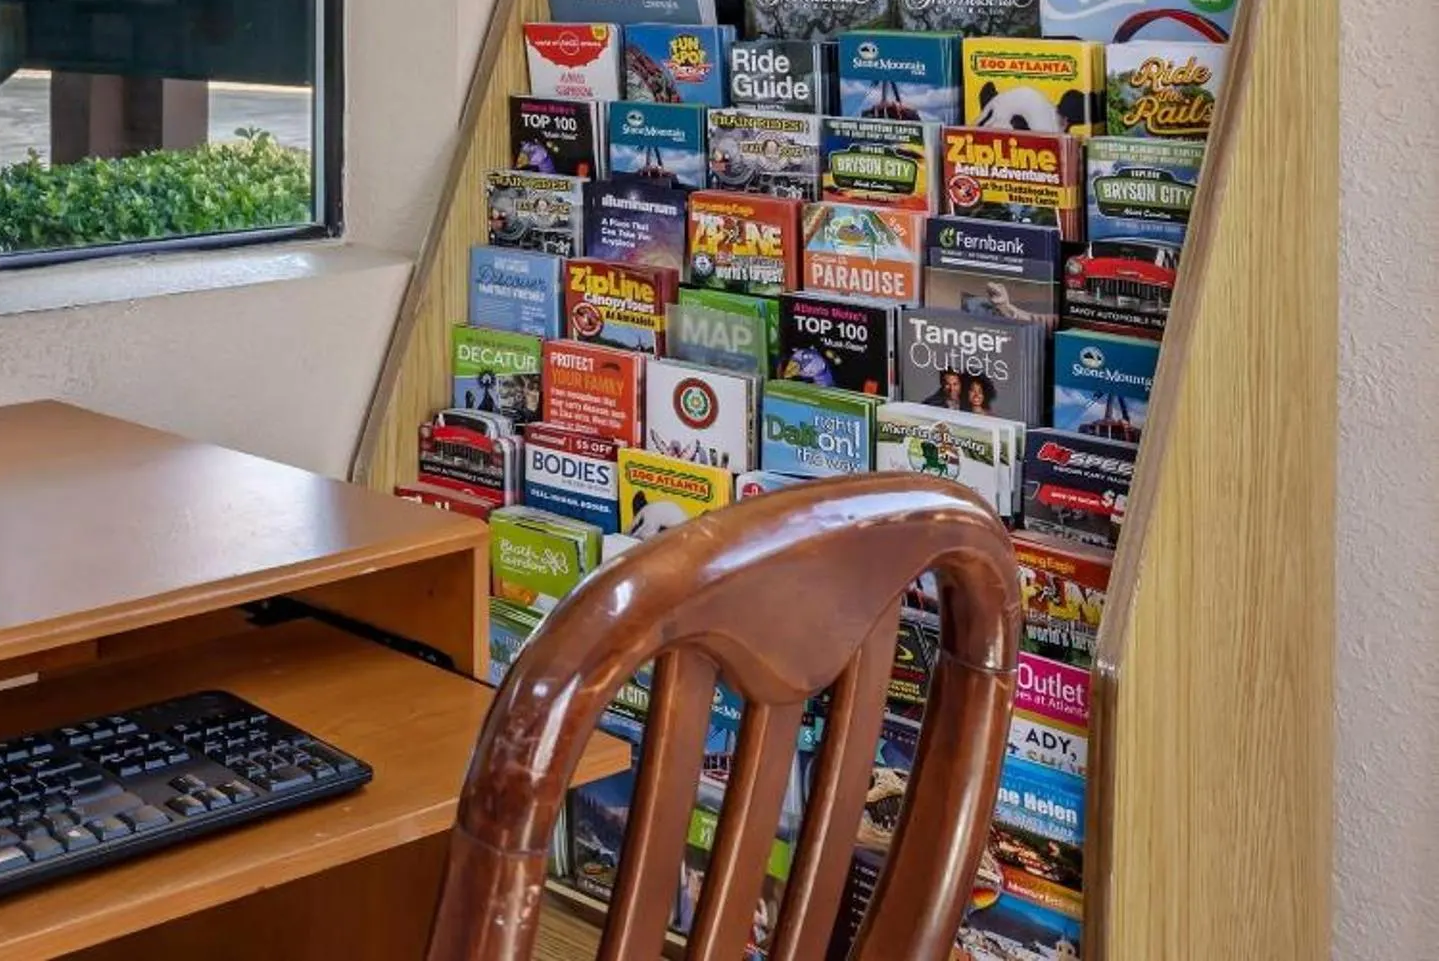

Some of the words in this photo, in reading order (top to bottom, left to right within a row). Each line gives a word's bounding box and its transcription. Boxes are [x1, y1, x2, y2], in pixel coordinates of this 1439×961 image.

[732, 48, 790, 73] Ride
[978, 57, 1006, 71] ZOO
[1009, 59, 1073, 74] ATLANTA
[1131, 56, 1212, 88] Ride
[733, 74, 810, 101] Guide
[521, 113, 551, 129] TOP
[554, 116, 578, 131] 100
[1124, 94, 1215, 129] Rails
[946, 134, 1058, 171] ZipLine
[838, 156, 882, 176] BRYSON
[885, 161, 911, 177] CITY
[955, 162, 989, 177] Aerial
[991, 166, 1060, 184] Adventures
[602, 193, 677, 216] illuminarium
[1103, 182, 1156, 202] BRYSON
[1160, 185, 1192, 205] CITY
[956, 231, 1025, 254] Fernbank
[569, 265, 655, 303] ZipLine
[812, 263, 906, 296] PARADISE
[793, 302, 829, 316] Atlanta
[1070, 305, 1096, 317] SAVOY
[681, 312, 754, 353] MAP
[793, 315, 832, 334] TOP
[835, 321, 869, 342] 100
[909, 318, 1010, 354] Tanger
[457, 344, 537, 372] DECATUR
[550, 351, 594, 372] PROTECT
[910, 341, 1009, 381] Outlets
[552, 368, 582, 390] YOUR
[583, 374, 625, 398] FAMILY
[814, 415, 854, 434] right
[576, 440, 589, 451] $5
[590, 442, 613, 455] OFF
[797, 446, 824, 467] the
[533, 450, 610, 485] BODIES
[630, 468, 657, 482] ZOO
[658, 475, 709, 497] ATLANTA
[1017, 662, 1085, 707] Outlet
[1034, 695, 1045, 706] at
[1023, 792, 1077, 824] Helen
